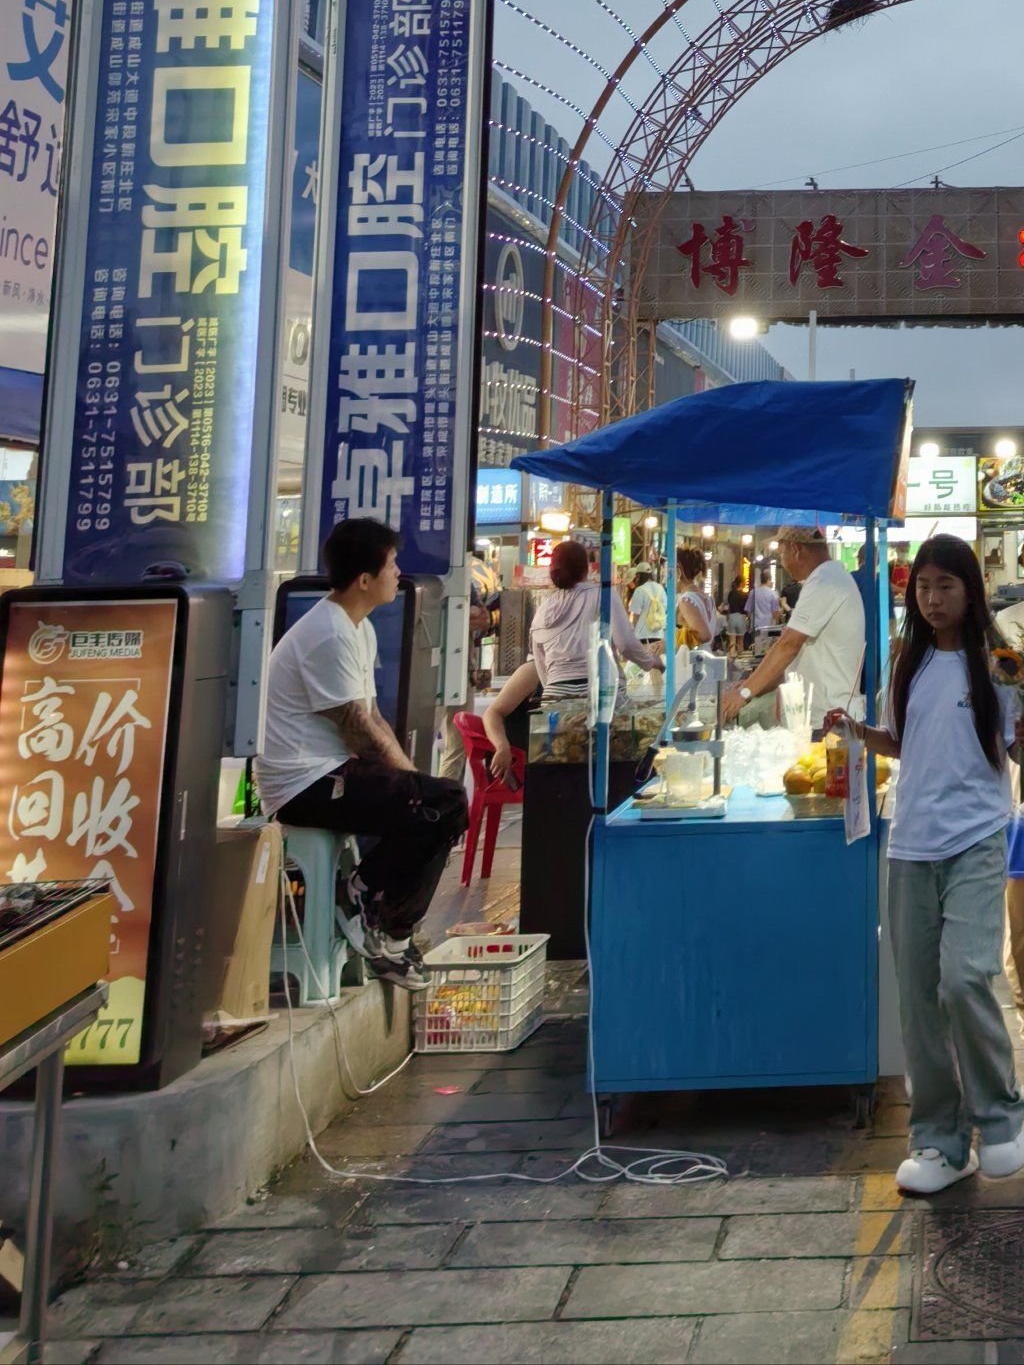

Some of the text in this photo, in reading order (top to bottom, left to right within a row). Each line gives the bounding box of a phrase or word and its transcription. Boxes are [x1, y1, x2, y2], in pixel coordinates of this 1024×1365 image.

[109, 648, 141, 658] MEDIA
[18, 676, 152, 777] 高价
[8, 770, 141, 858] 回收
